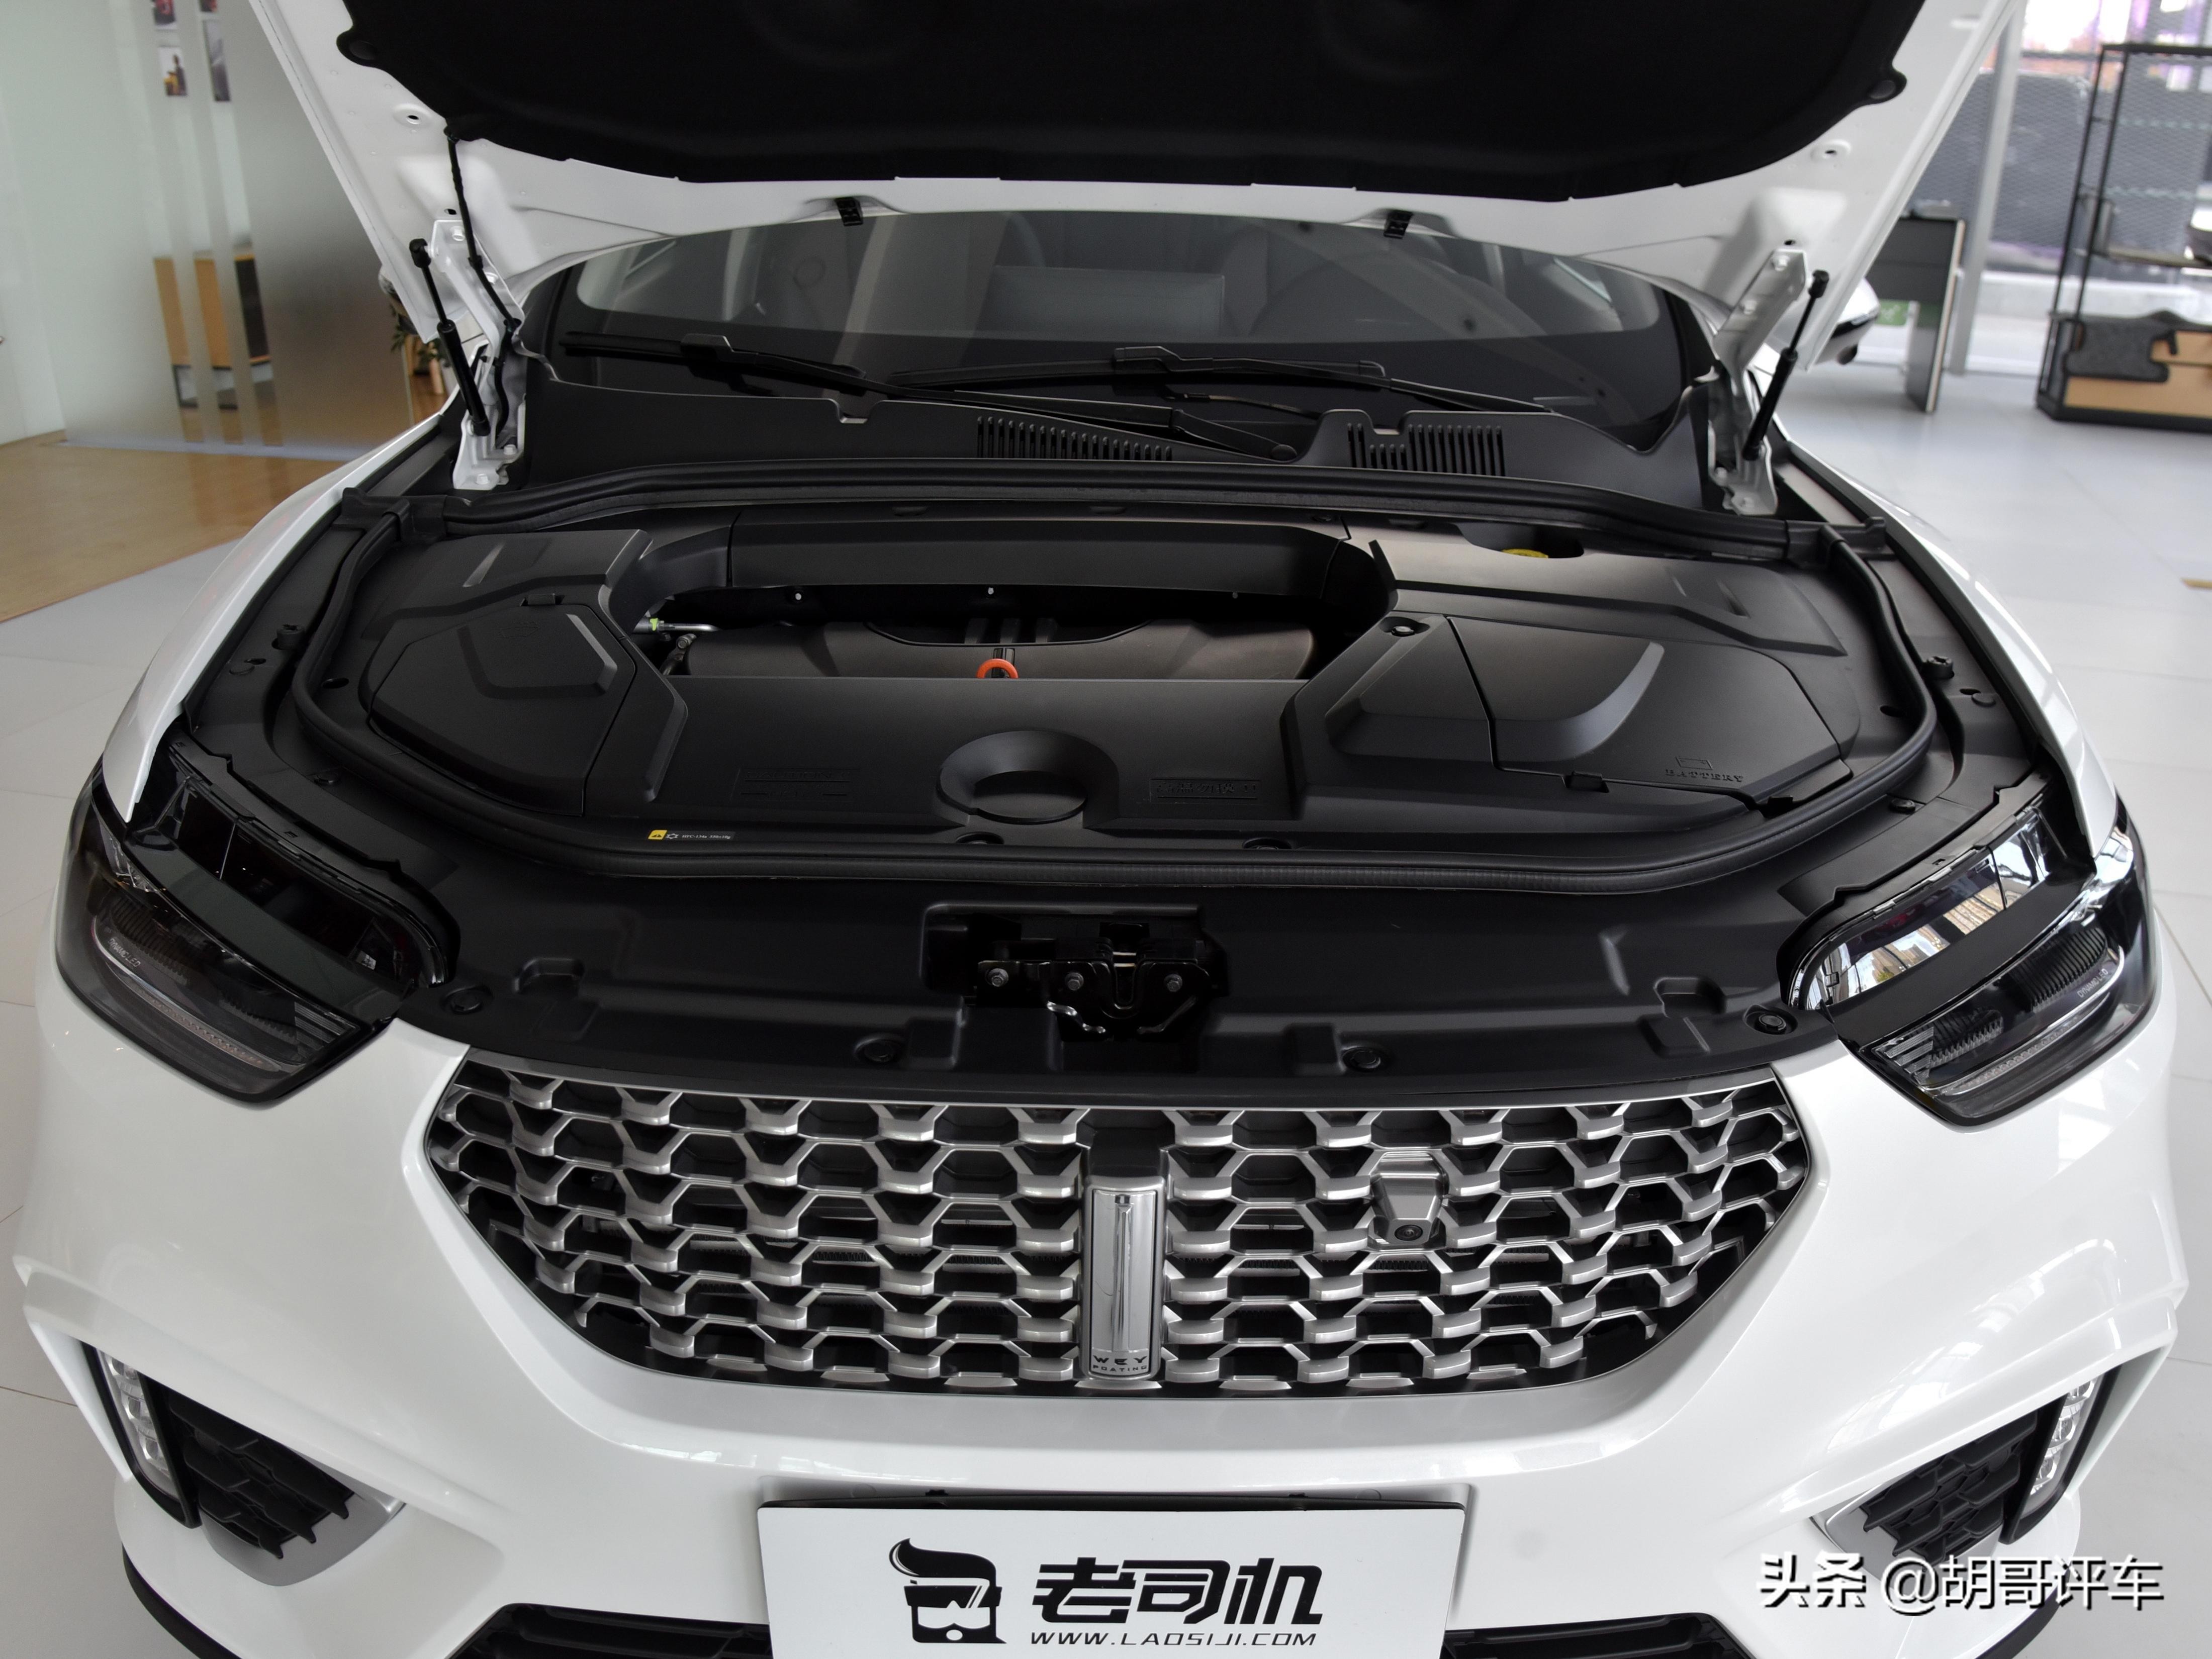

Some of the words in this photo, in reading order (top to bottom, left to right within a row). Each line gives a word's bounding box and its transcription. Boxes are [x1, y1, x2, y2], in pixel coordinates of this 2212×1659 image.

[1665, 769, 1744, 783] BATTERY
[1092, 1355, 1148, 1365] WEY
[1032, 1556, 1323, 1625] 老司机
[1031, 1631, 1317, 1646] WWW.LAOSIJI.COM
